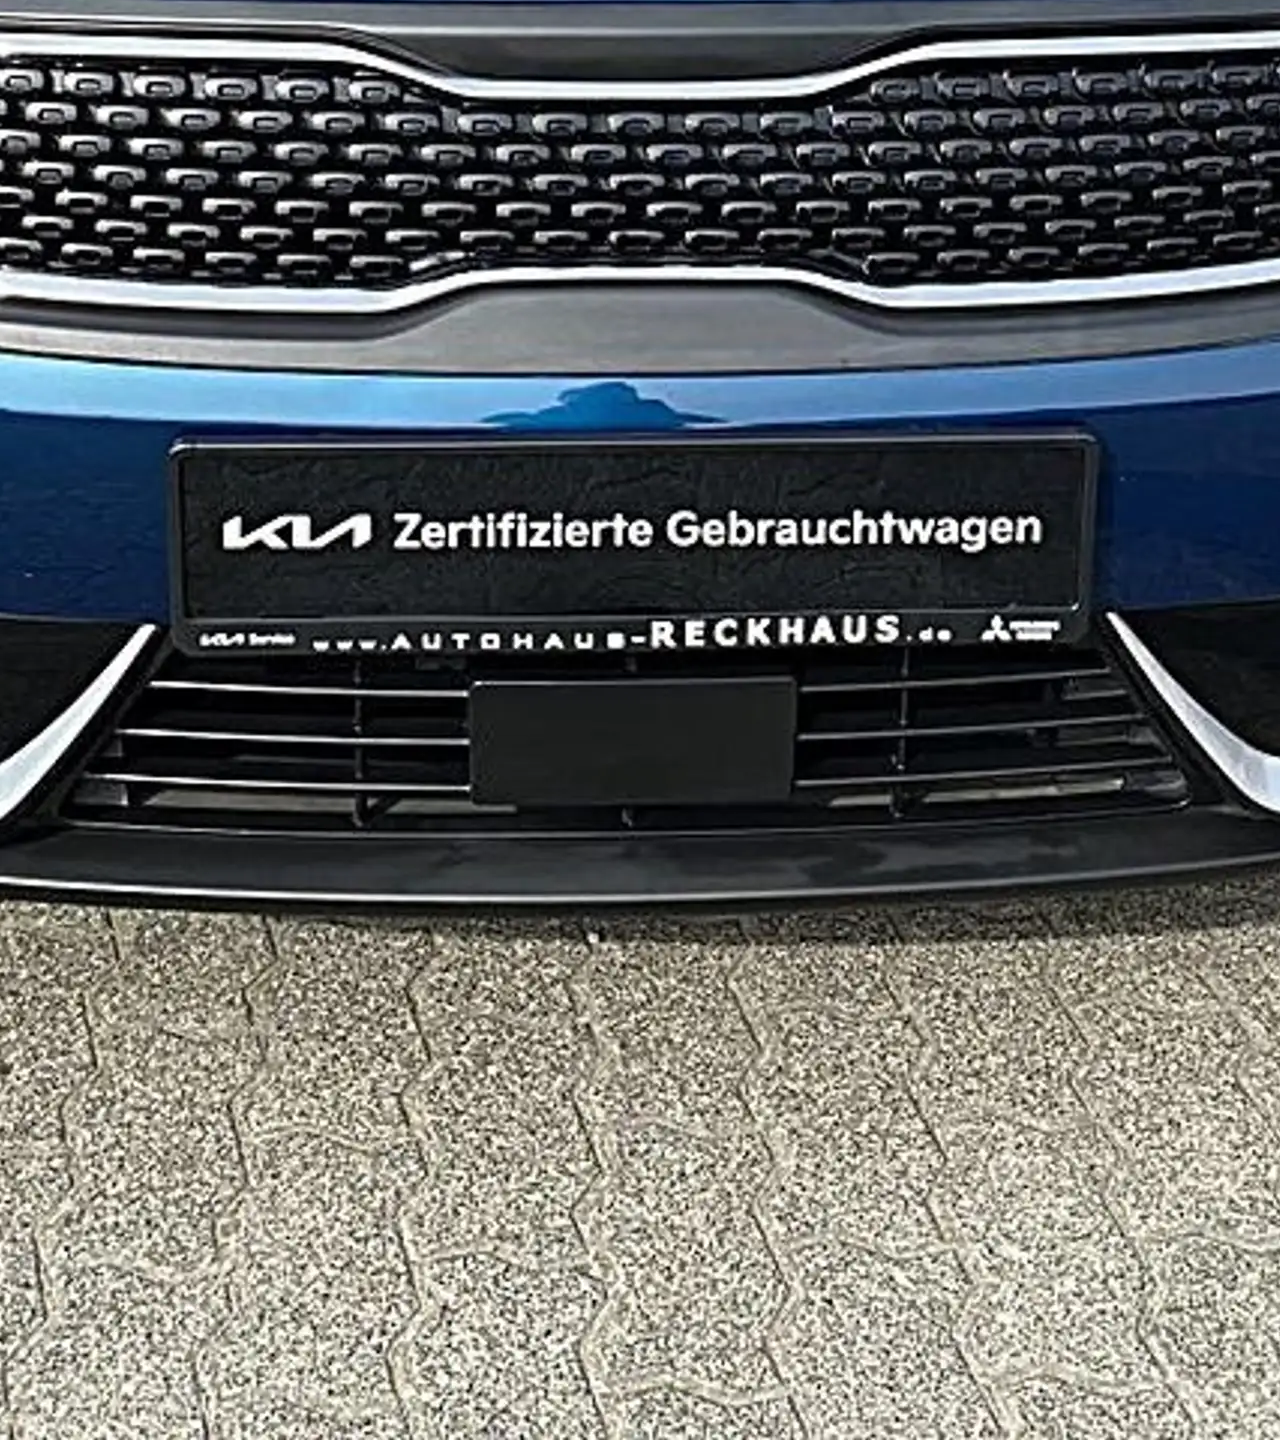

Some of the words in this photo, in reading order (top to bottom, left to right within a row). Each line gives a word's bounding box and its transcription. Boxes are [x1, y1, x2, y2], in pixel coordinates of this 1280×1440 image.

[222, 514, 372, 550] KIA
[393, 512, 653, 550] Zertifizierte
[666, 509, 1043, 553] Gebrauchtwagen
